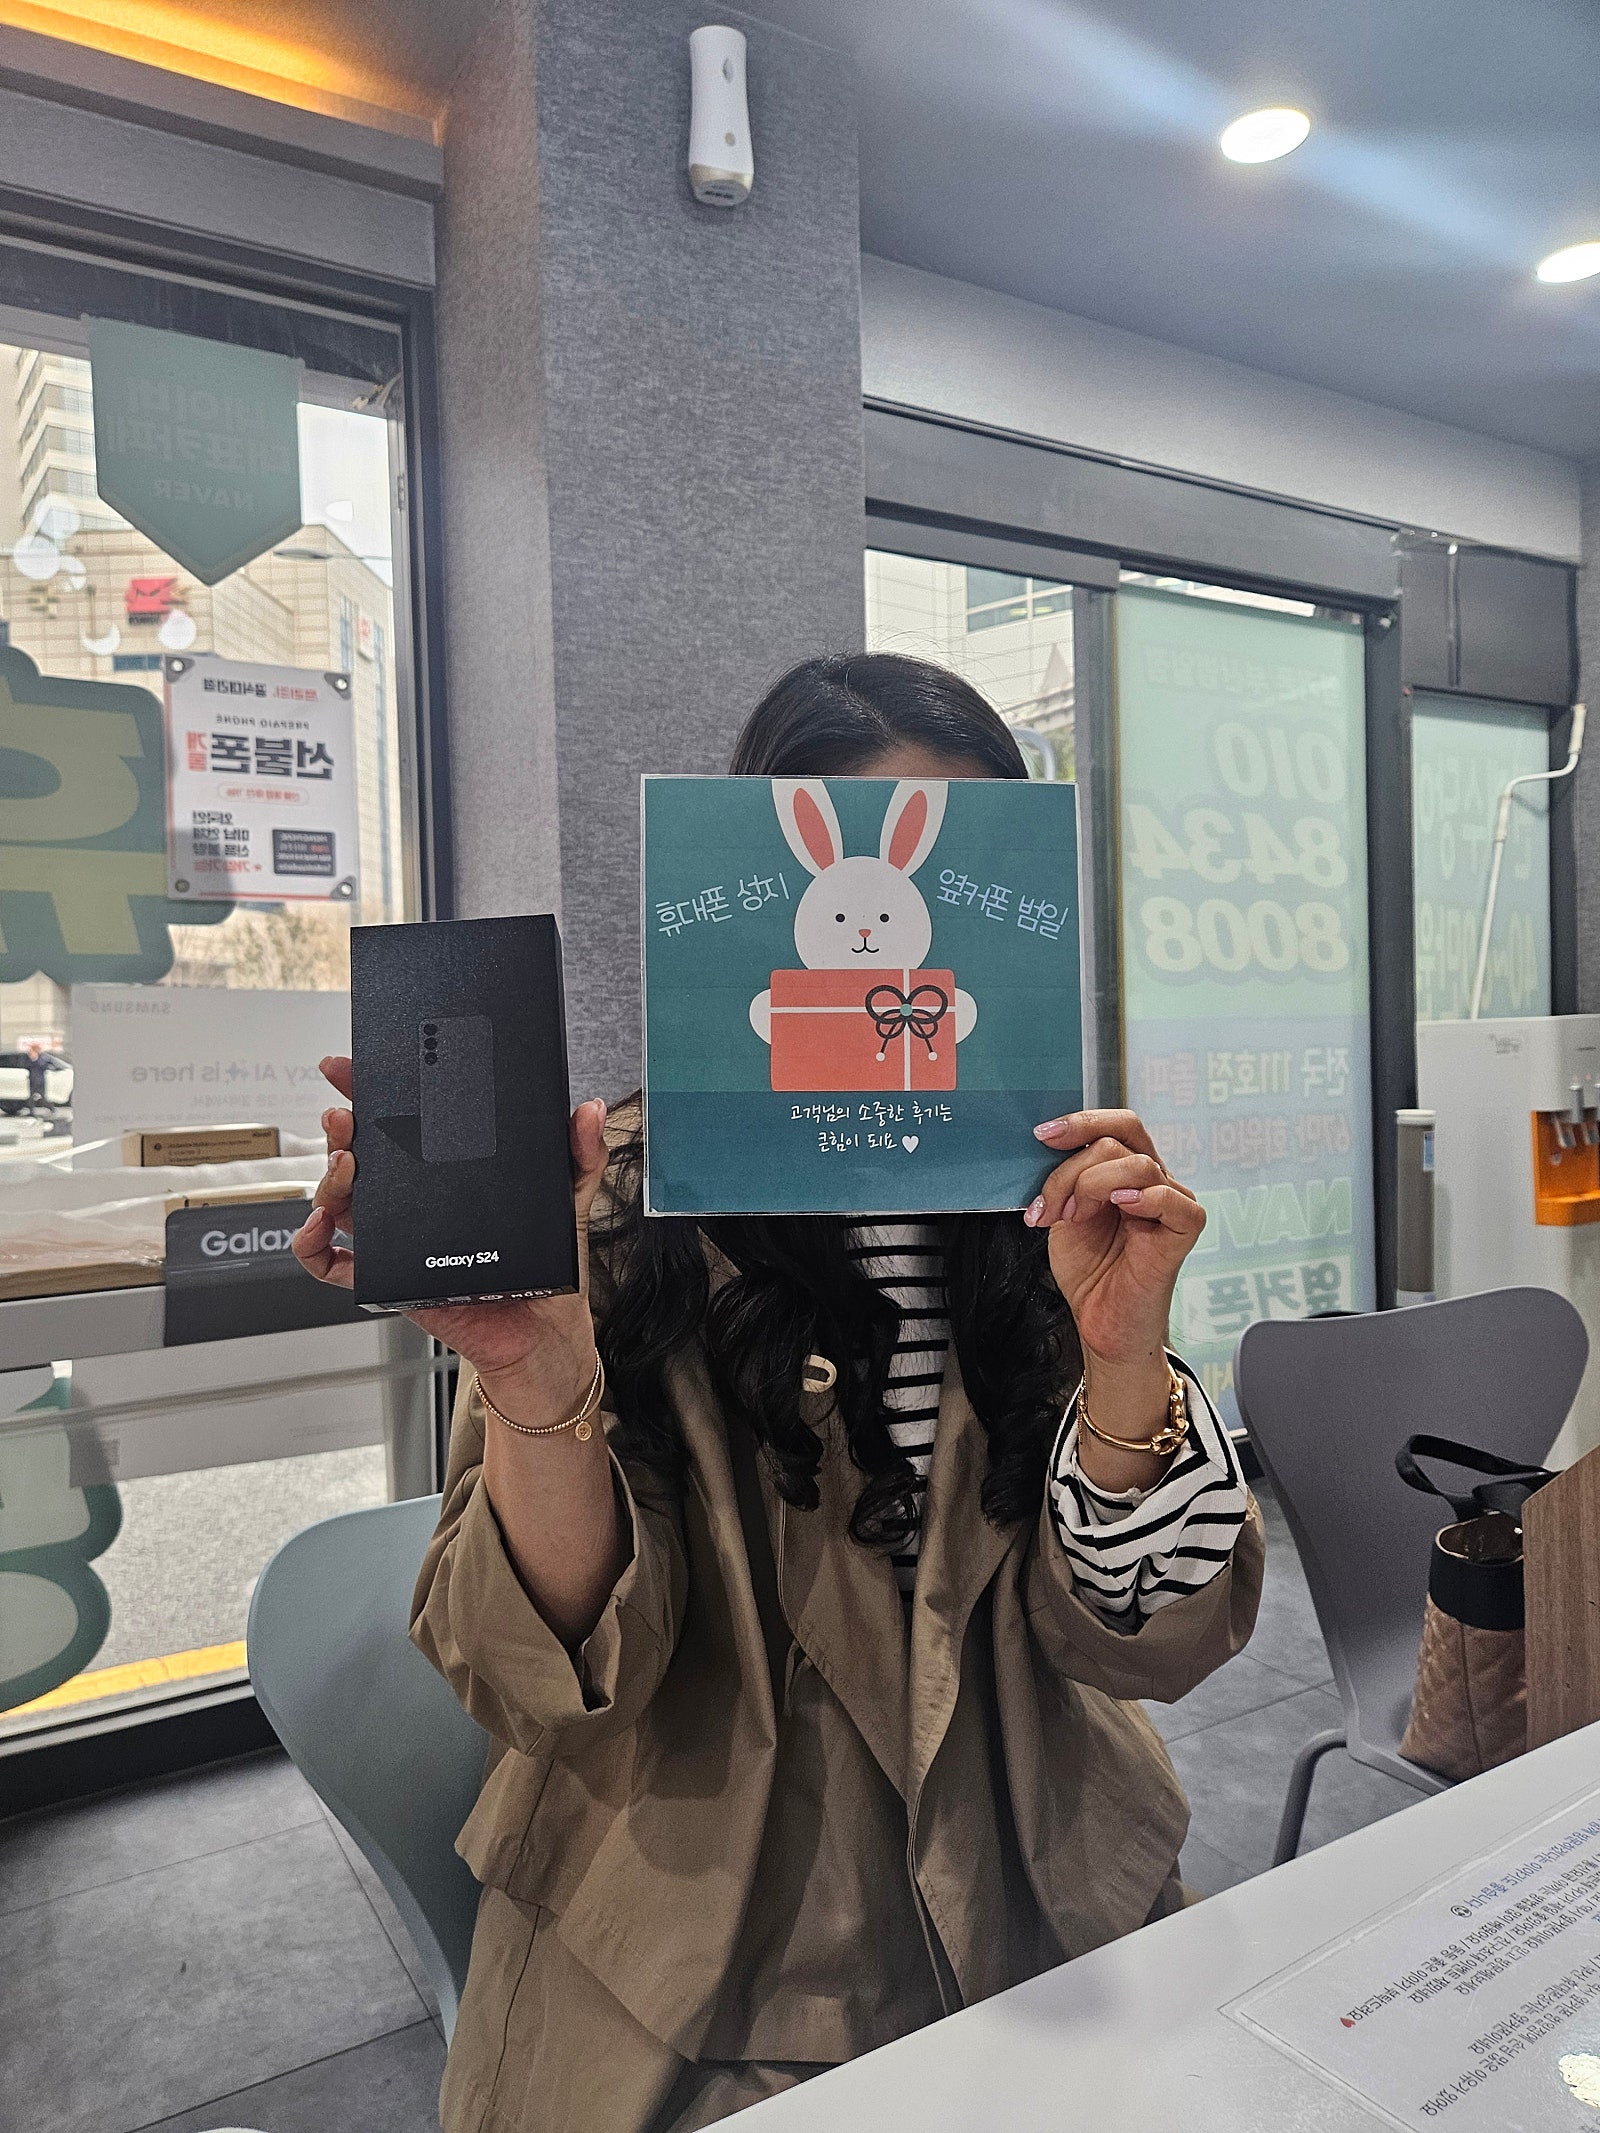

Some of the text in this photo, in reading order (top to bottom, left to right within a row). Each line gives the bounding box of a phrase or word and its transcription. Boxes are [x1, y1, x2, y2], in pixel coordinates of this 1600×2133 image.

[655, 872, 791, 938] 휴대폰 성지
[937, 868, 1069, 940] 옆커폰 범일
[790, 1101, 952, 1123] 고객님의 소중한 후기는
[817, 1132, 898, 1153] 큰힘이 되요
[200, 1225, 297, 1256] Galax
[425, 1250, 500, 1268] Galaxy S24
[1463, 1881, 1509, 1909] 좋습니다
[1440, 1944, 1466, 1961] 등등
[1504, 1944, 1530, 1961] 믿고
[1420, 1956, 1448, 1973] 좋은
[1443, 1959, 1478, 1980] 이벤트
[1392, 1969, 1428, 1992] 이야기
[1553, 1993, 1589, 2018] 옆커폰
[1498, 2037, 1526, 2059] 손님
[1478, 2052, 1509, 2072] 많은
[1449, 2068, 1487, 2095] 이유가
[1419, 2088, 1458, 2116] 있어요
